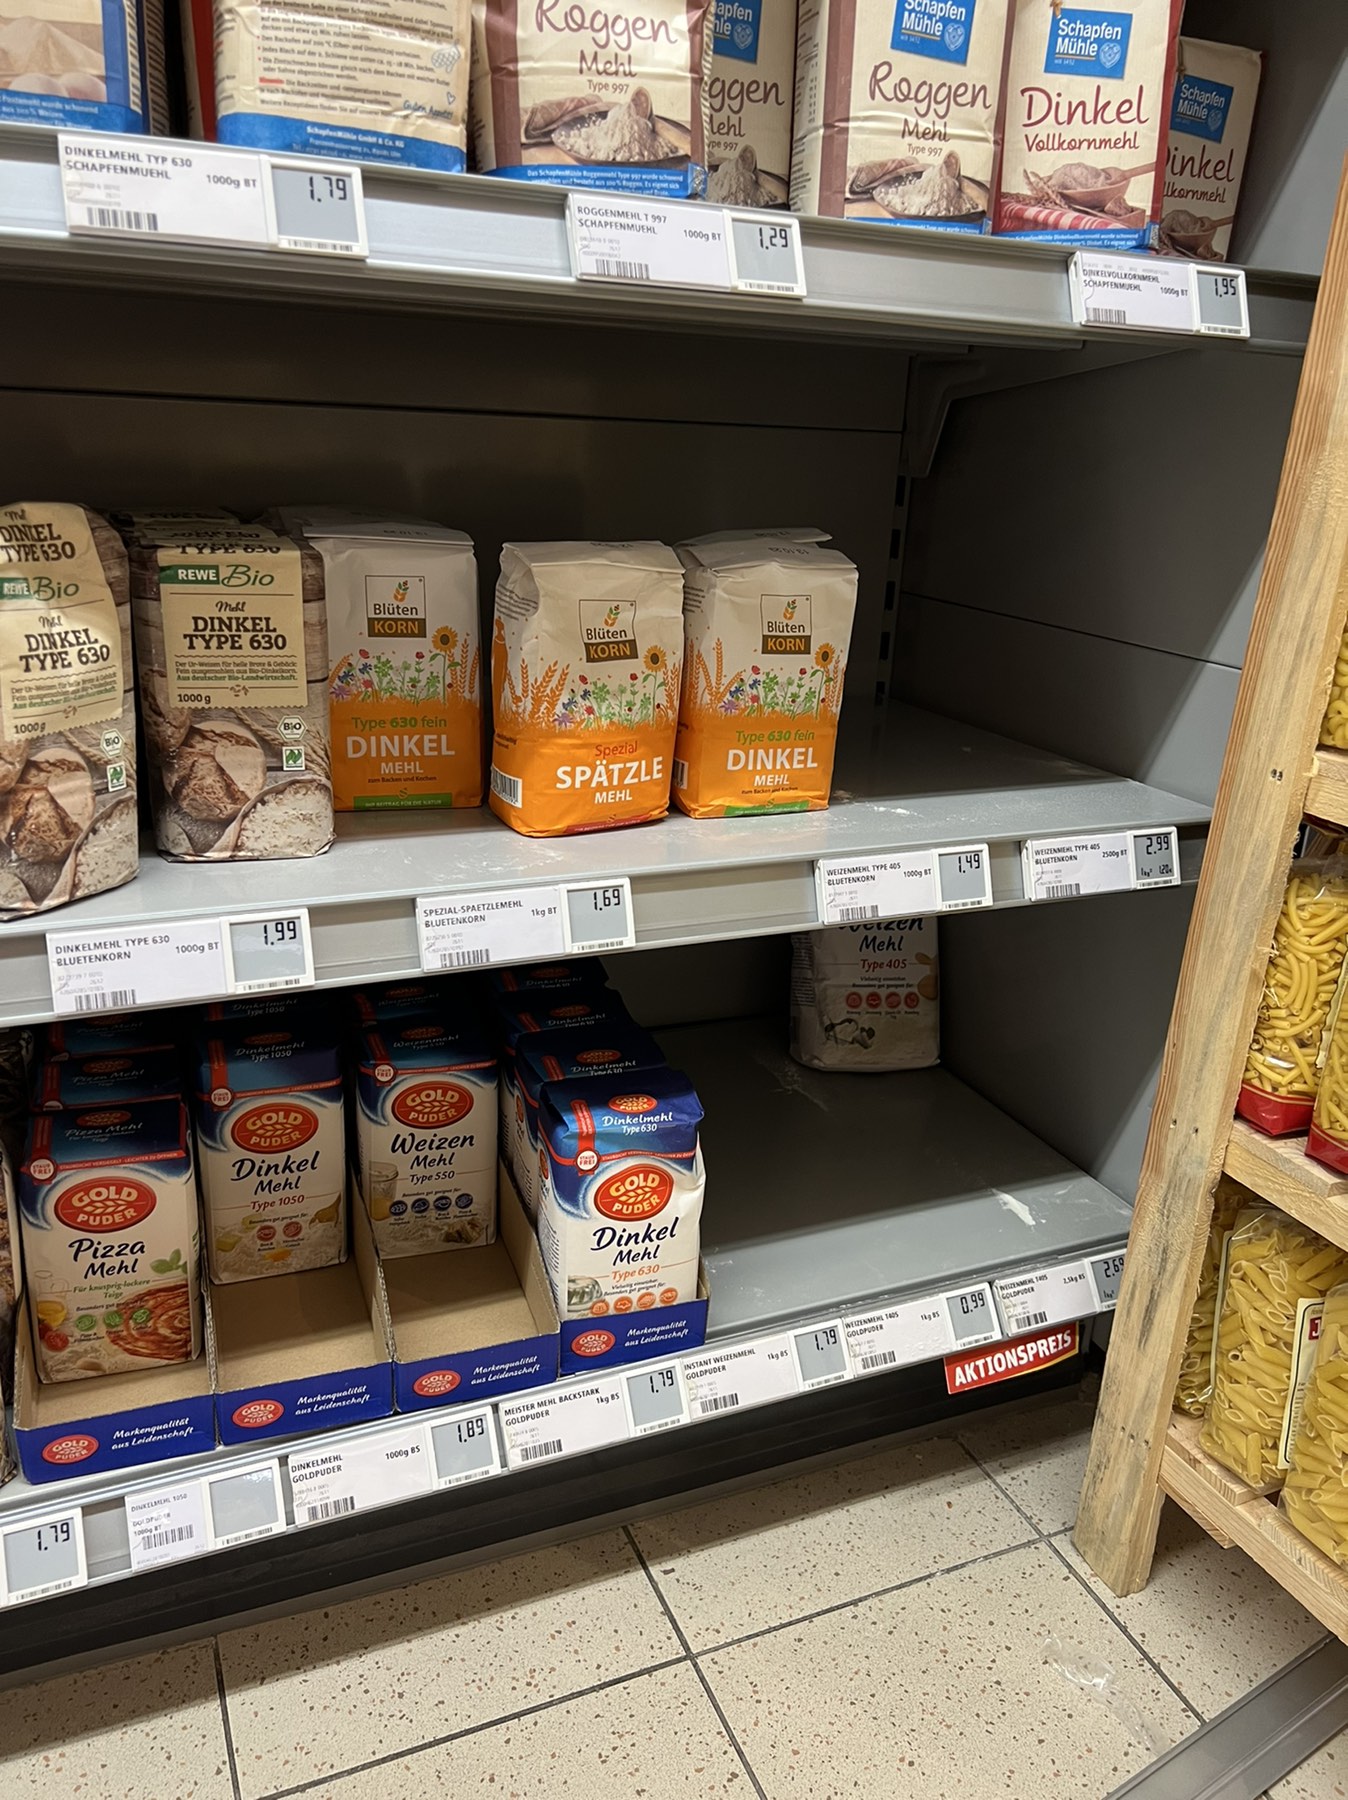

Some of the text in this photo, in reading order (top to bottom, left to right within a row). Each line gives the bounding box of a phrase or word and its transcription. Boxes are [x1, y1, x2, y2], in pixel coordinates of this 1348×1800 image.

[905, 0, 966, 21] Schapfen
[536, 0, 678, 51] Roggen
[902, 11, 943, 36] Mühle
[1059, 19, 1122, 41] Schapfen
[1055, 37, 1098, 56] Mühle
[579, 50, 638, 78] Mehl
[587, 79, 629, 94] Type 997
[870, 60, 992, 120] Roggen
[1020, 84, 1149, 128] Dinkel
[902, 118, 951, 142] Mehl
[908, 143, 943, 157] Type 997
[1025, 131, 1140, 153] Vollkornmehl
[64, 146, 192, 168] DINKELMEHL TYP 630
[65, 161, 172, 180] SCHAPFENMUEHL
[206, 174, 257, 189] 1000g BT
[577, 206, 667, 224] ROGGENMEHL T 997
[578, 219, 657, 235] SCHAPFENMUEHL
[684, 229, 721, 242] 1000g BT
[1083, 269, 1160, 283] DINKELVOLLKORNMEHL
[1083, 280, 1142, 292] SCHAPFENMUEHL
[177, 564, 275, 587] REWE Bio
[373, 603, 419, 616] Blüten
[192, 617, 277, 633] DINKEL
[374, 620, 419, 634] KORN
[585, 627, 628, 641] Blüten
[767, 621, 806, 634] Blüten
[24, 628, 98, 653] DINKEL
[183, 634, 287, 650] TYPE 630
[767, 638, 806, 651] KORN
[20, 645, 110, 673] TYPE 630
[589, 642, 631, 660] KORN
[352, 716, 447, 732] Type 630 fein
[346, 735, 456, 759] DINKEL
[594, 741, 639, 759] Spezial
[380, 762, 424, 774] MEHL
[726, 747, 819, 772] DINKEL
[555, 756, 664, 790] SPÄTZLE
[754, 774, 791, 786] MEHL
[595, 790, 633, 805] MEHL
[1034, 842, 1100, 856] WEIZENMEHL TYPE 405
[826, 862, 901, 877] WEIZENMEHL TYPE 405
[1035, 854, 1078, 867] BLUETENKORN
[827, 875, 876, 886] BLUETENKORN
[423, 900, 523, 917] SPEZIAL-SPAETZLEMEHL
[531, 907, 557, 918] 1kg BT
[425, 914, 486, 928] BLUETENKORN
[55, 935, 170, 955] DINKELMEHL TYPE 630
[175, 942, 219, 955] 1000g BT
[859, 935, 904, 953] Mehl
[56, 951, 131, 966] BLUETENKORN
[861, 959, 907, 972] Type 405
[406, 1089, 459, 1106] GOLD
[246, 1111, 304, 1131] GOLD
[408, 1109, 457, 1123] PUDER
[602, 1112, 673, 1126] Dinkelmehl
[622, 1124, 657, 1135] Type 630
[250, 1131, 302, 1147] PUDER
[391, 1132, 475, 1155] Weizen
[230, 1150, 320, 1182] Dinkel
[410, 1153, 455, 1169] Mehl
[254, 1176, 301, 1195] Mehl
[409, 1170, 455, 1185] Type 550
[609, 1173, 661, 1197] GOLD
[71, 1186, 139, 1207] GOLD
[250, 1194, 304, 1212] Type 1050
[612, 1194, 661, 1214] PUDER
[76, 1207, 137, 1225] PUDER
[590, 1217, 680, 1251] Dinkel
[68, 1237, 145, 1262] Pizza
[613, 1244, 660, 1266] Mehl
[84, 1258, 139, 1279] Mehl
[612, 1264, 660, 1282] Type 630
[73, 1285, 87, 1293] Für
[1001, 1286, 1035, 1300] GOLDPUDER
[627, 1320, 687, 1337] Markenqualität
[844, 1314, 884, 1330] WEIZENMEHL
[846, 1323, 884, 1338] GOLDPUDER
[625, 1329, 689, 1347] aus Leidenschaft
[684, 1348, 755, 1371] INSTANT WEIZENMEHL
[953, 1329, 1072, 1388] AKTIONSPREIS
[685, 1365, 727, 1380] GOLDPUDER
[504, 1388, 601, 1417] MEISTER MEHL BACKSTARK
[505, 1409, 550, 1427] GOLDPUDER
[113, 1417, 190, 1440] Markenqualität
[112, 1426, 194, 1450] aus Leidenschaft
[385, 1445, 421, 1460] 1000g BS
[290, 1454, 343, 1473] DINKELMEHL
[292, 1464, 342, 1484] GOLDPUDER
